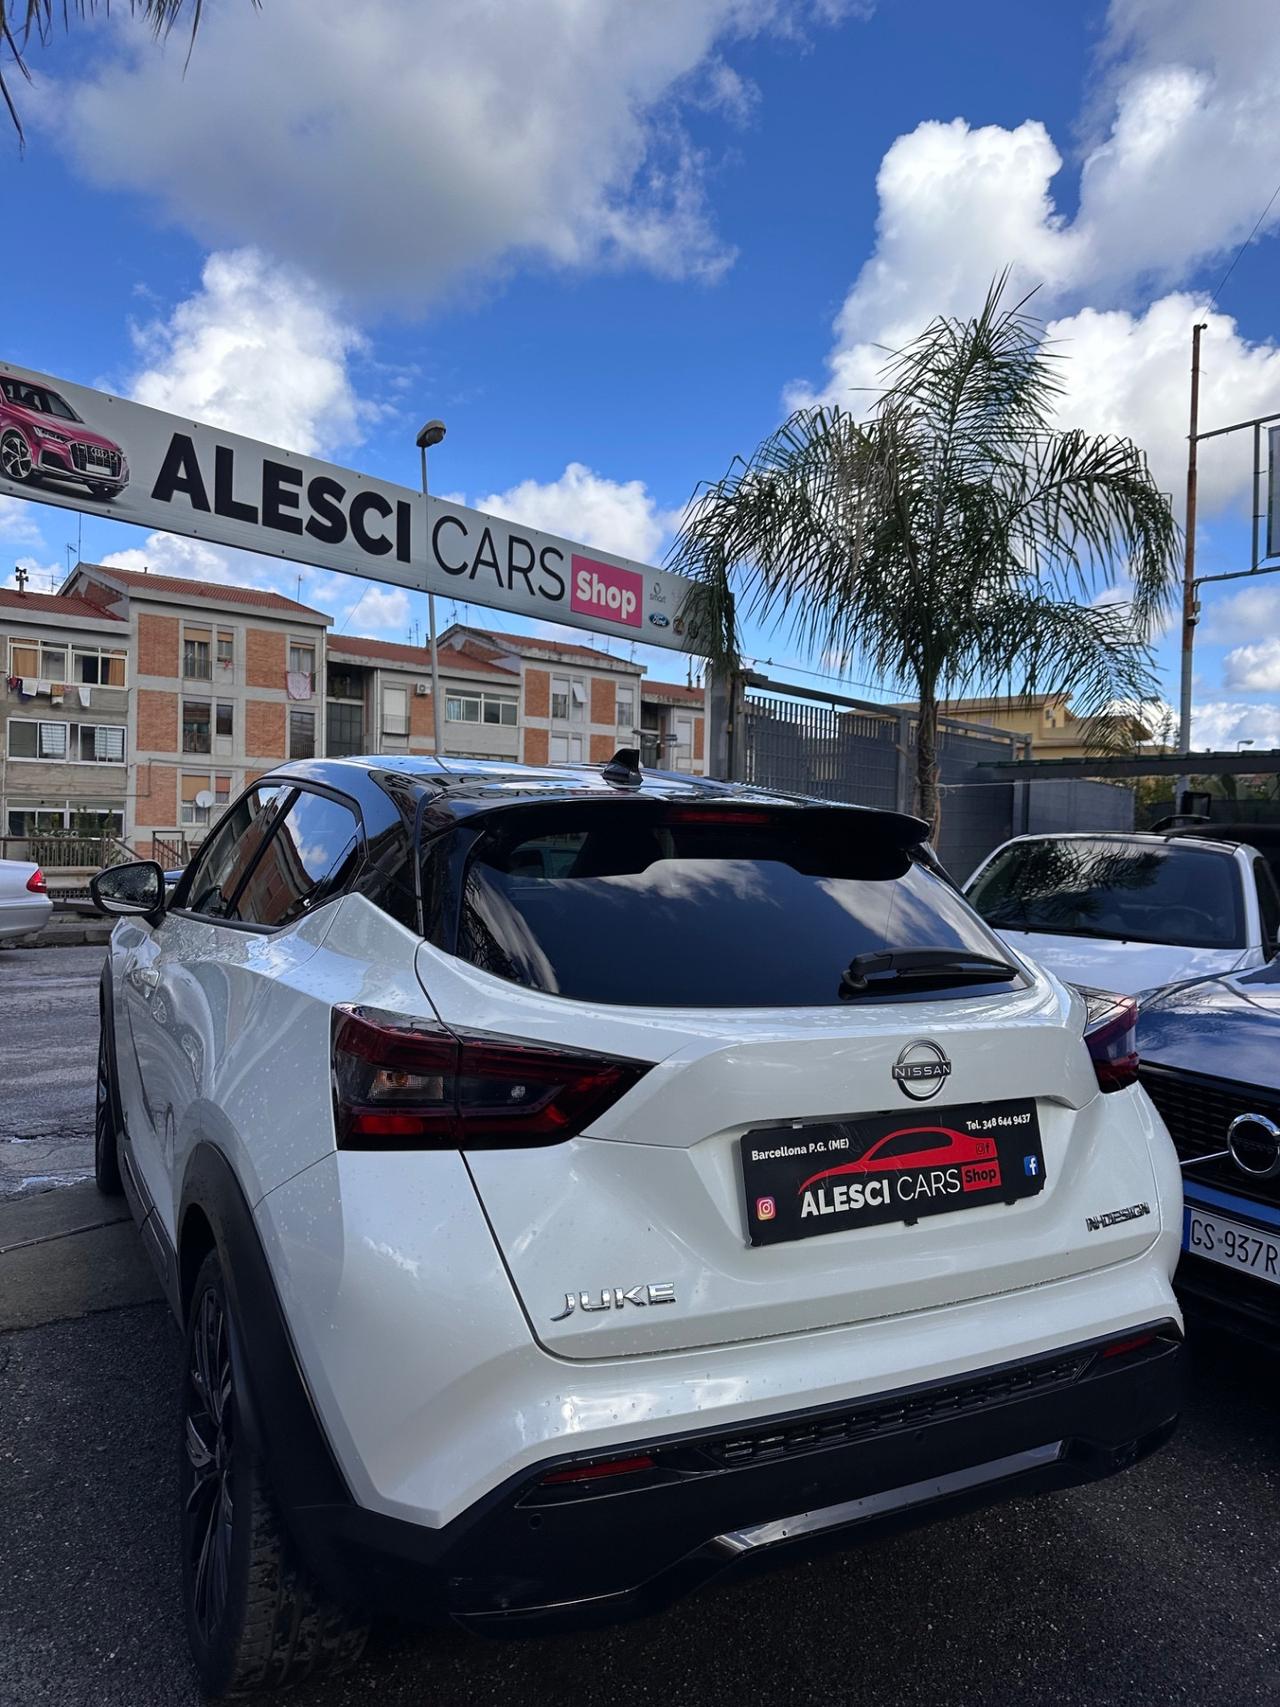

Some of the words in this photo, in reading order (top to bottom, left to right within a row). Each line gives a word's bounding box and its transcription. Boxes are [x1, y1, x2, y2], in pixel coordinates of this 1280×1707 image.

[151, 432, 411, 563] ALESCI
[432, 515, 565, 601] CARS
[576, 570, 636, 619] Shop
[894, 1064, 950, 1077] NISSAN
[982, 1117, 997, 1130] 348
[998, 1116, 1012, 1126] 644
[1012, 1113, 1030, 1125] 9437
[752, 1146, 807, 1161] Barcellona
[809, 1142, 827, 1153] P.G.
[828, 1138, 849, 1151] (ME)
[800, 1179, 891, 1218] ALESCI
[897, 1169, 961, 1201] CARS
[965, 1168, 997, 1184] Shop
[550, 1281, 676, 1322] JUKE
